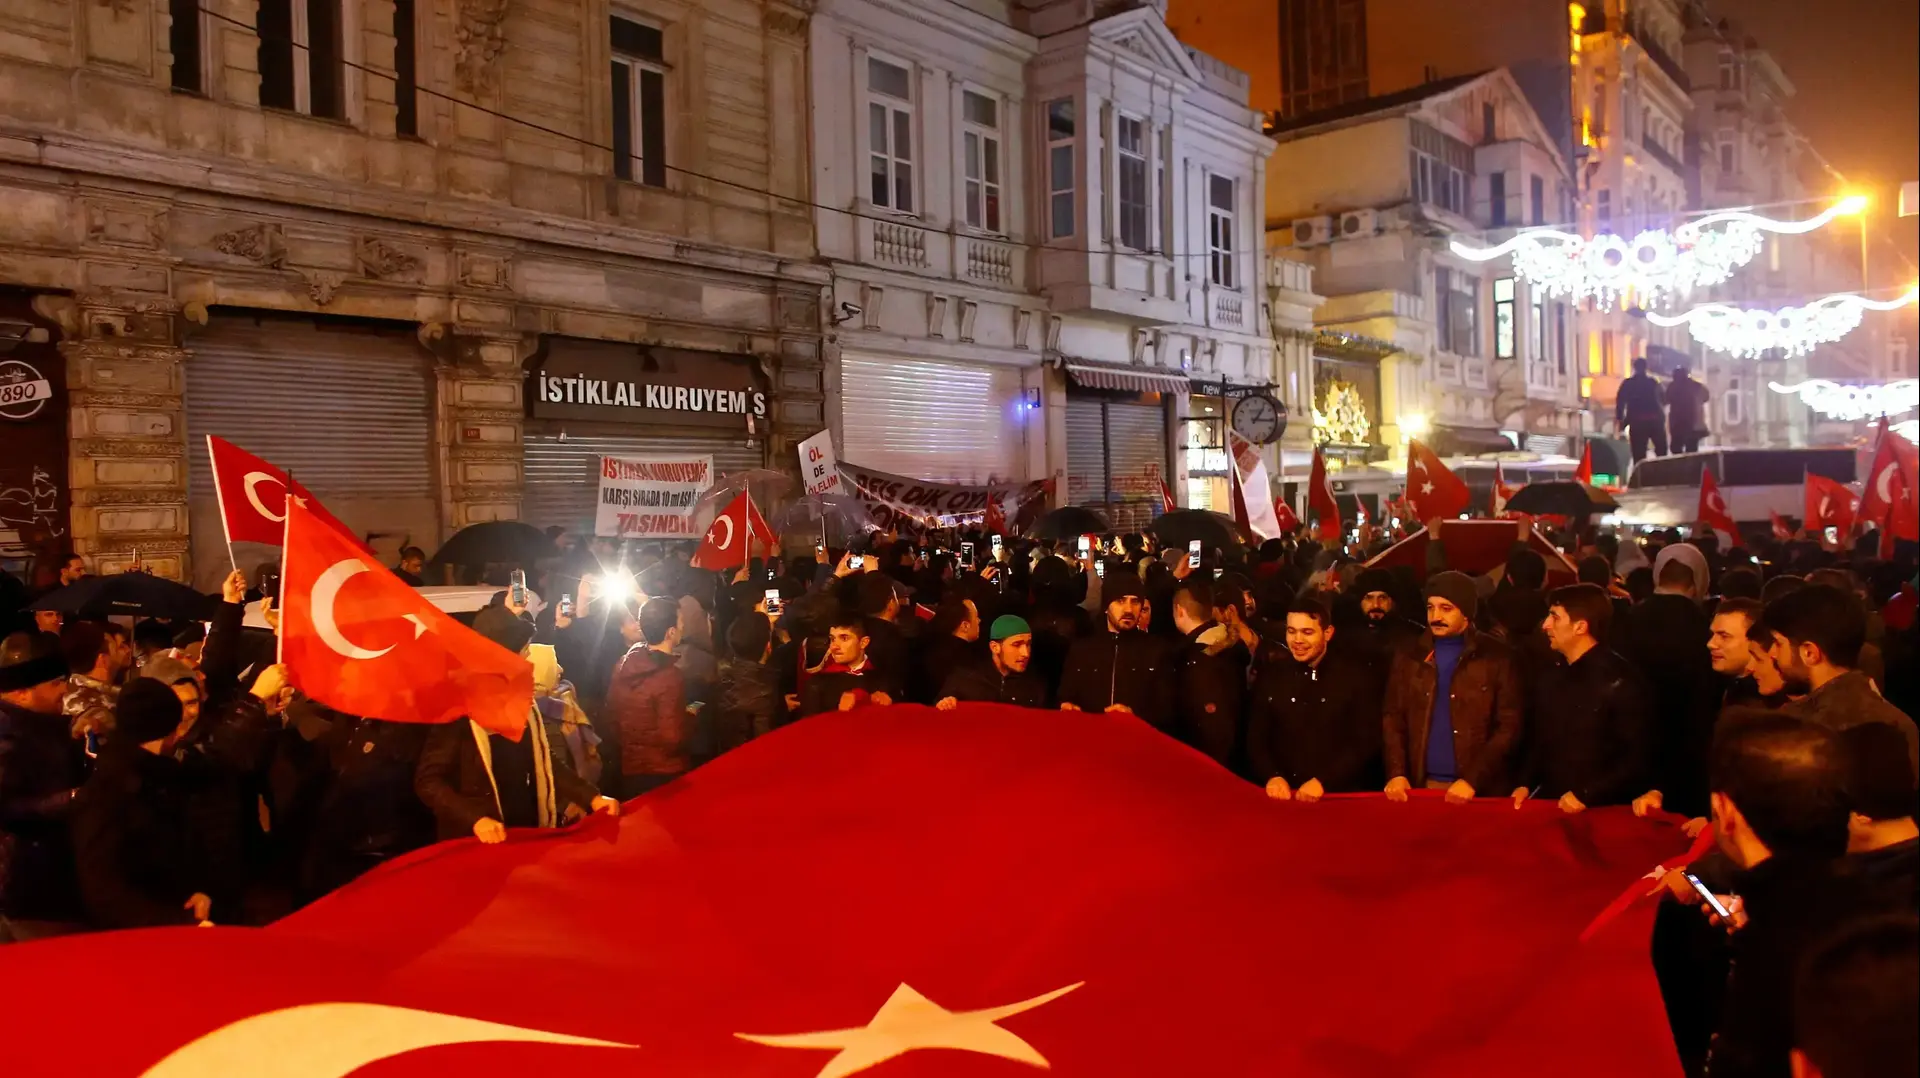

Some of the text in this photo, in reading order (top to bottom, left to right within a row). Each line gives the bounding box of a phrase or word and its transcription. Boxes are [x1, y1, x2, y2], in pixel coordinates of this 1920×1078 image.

[0, 383, 36, 403] 890
[539, 370, 642, 407] İSTİKLAL
[809, 446, 824, 462] ÖL
[813, 464, 825, 478] DE
[602, 487, 632, 509] KARŞI
[661, 490, 671, 507] 10
